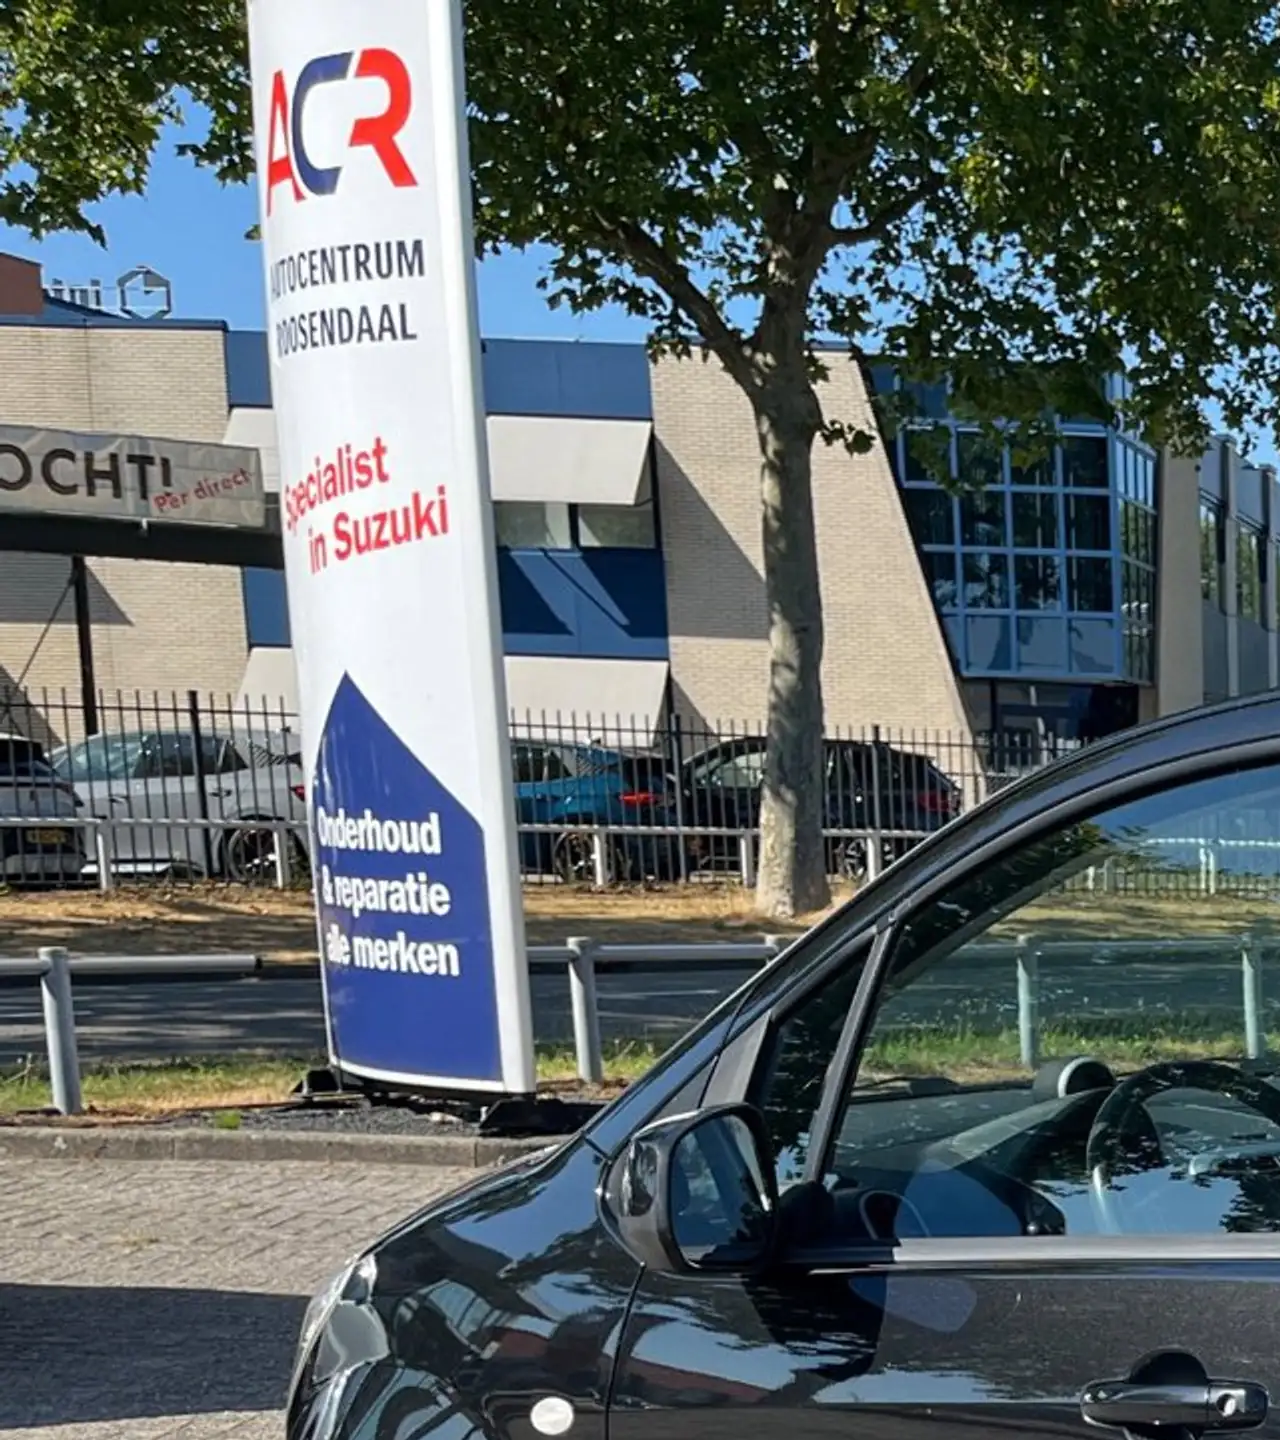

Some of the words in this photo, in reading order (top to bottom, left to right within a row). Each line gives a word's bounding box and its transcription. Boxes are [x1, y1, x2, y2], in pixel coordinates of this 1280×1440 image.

[266, 47, 419, 217] ACR
[152, 488, 188, 513] Per
[194, 468, 250, 500] direct
[307, 526, 328, 575] in
[333, 484, 449, 561] Suzuki
[317, 805, 442, 855] Onderhoud
[334, 871, 451, 918] reparatie
[352, 930, 460, 977] merken
